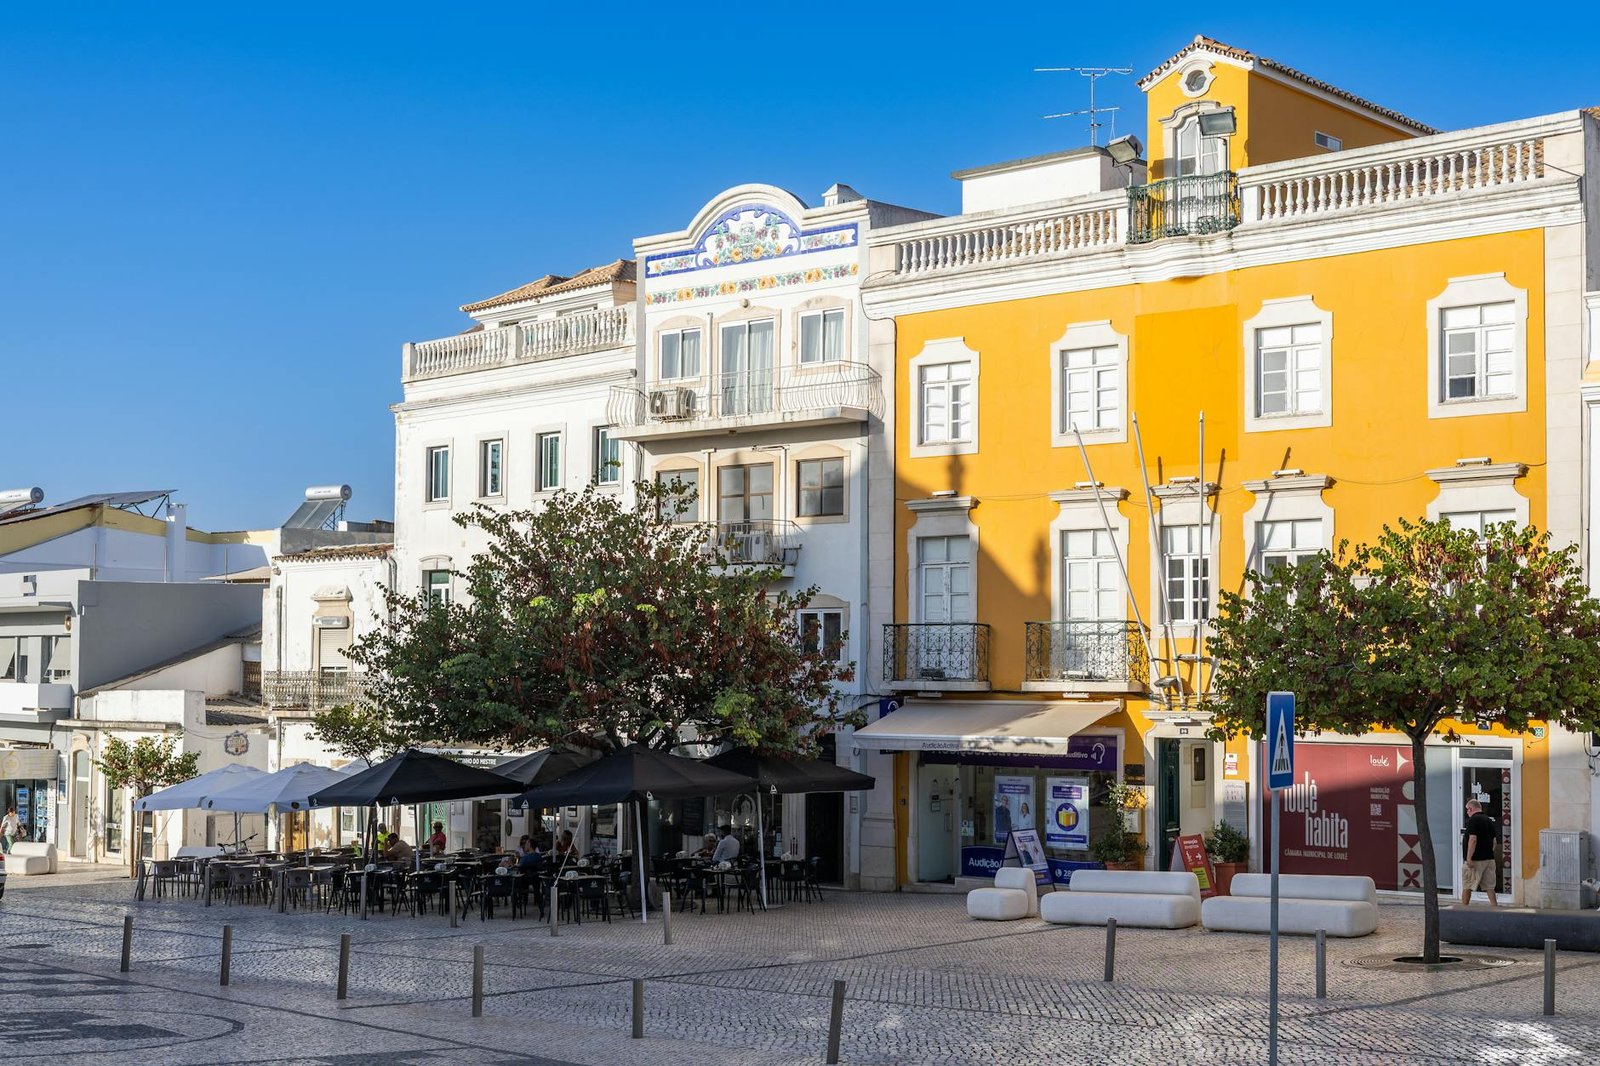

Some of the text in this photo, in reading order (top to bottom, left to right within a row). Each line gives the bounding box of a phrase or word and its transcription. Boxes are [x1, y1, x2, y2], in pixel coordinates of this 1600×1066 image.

[1305, 809, 1348, 848] habita
[1303, 849, 1326, 859] MUNICIPAL
[1327, 851, 1333, 859] DE
